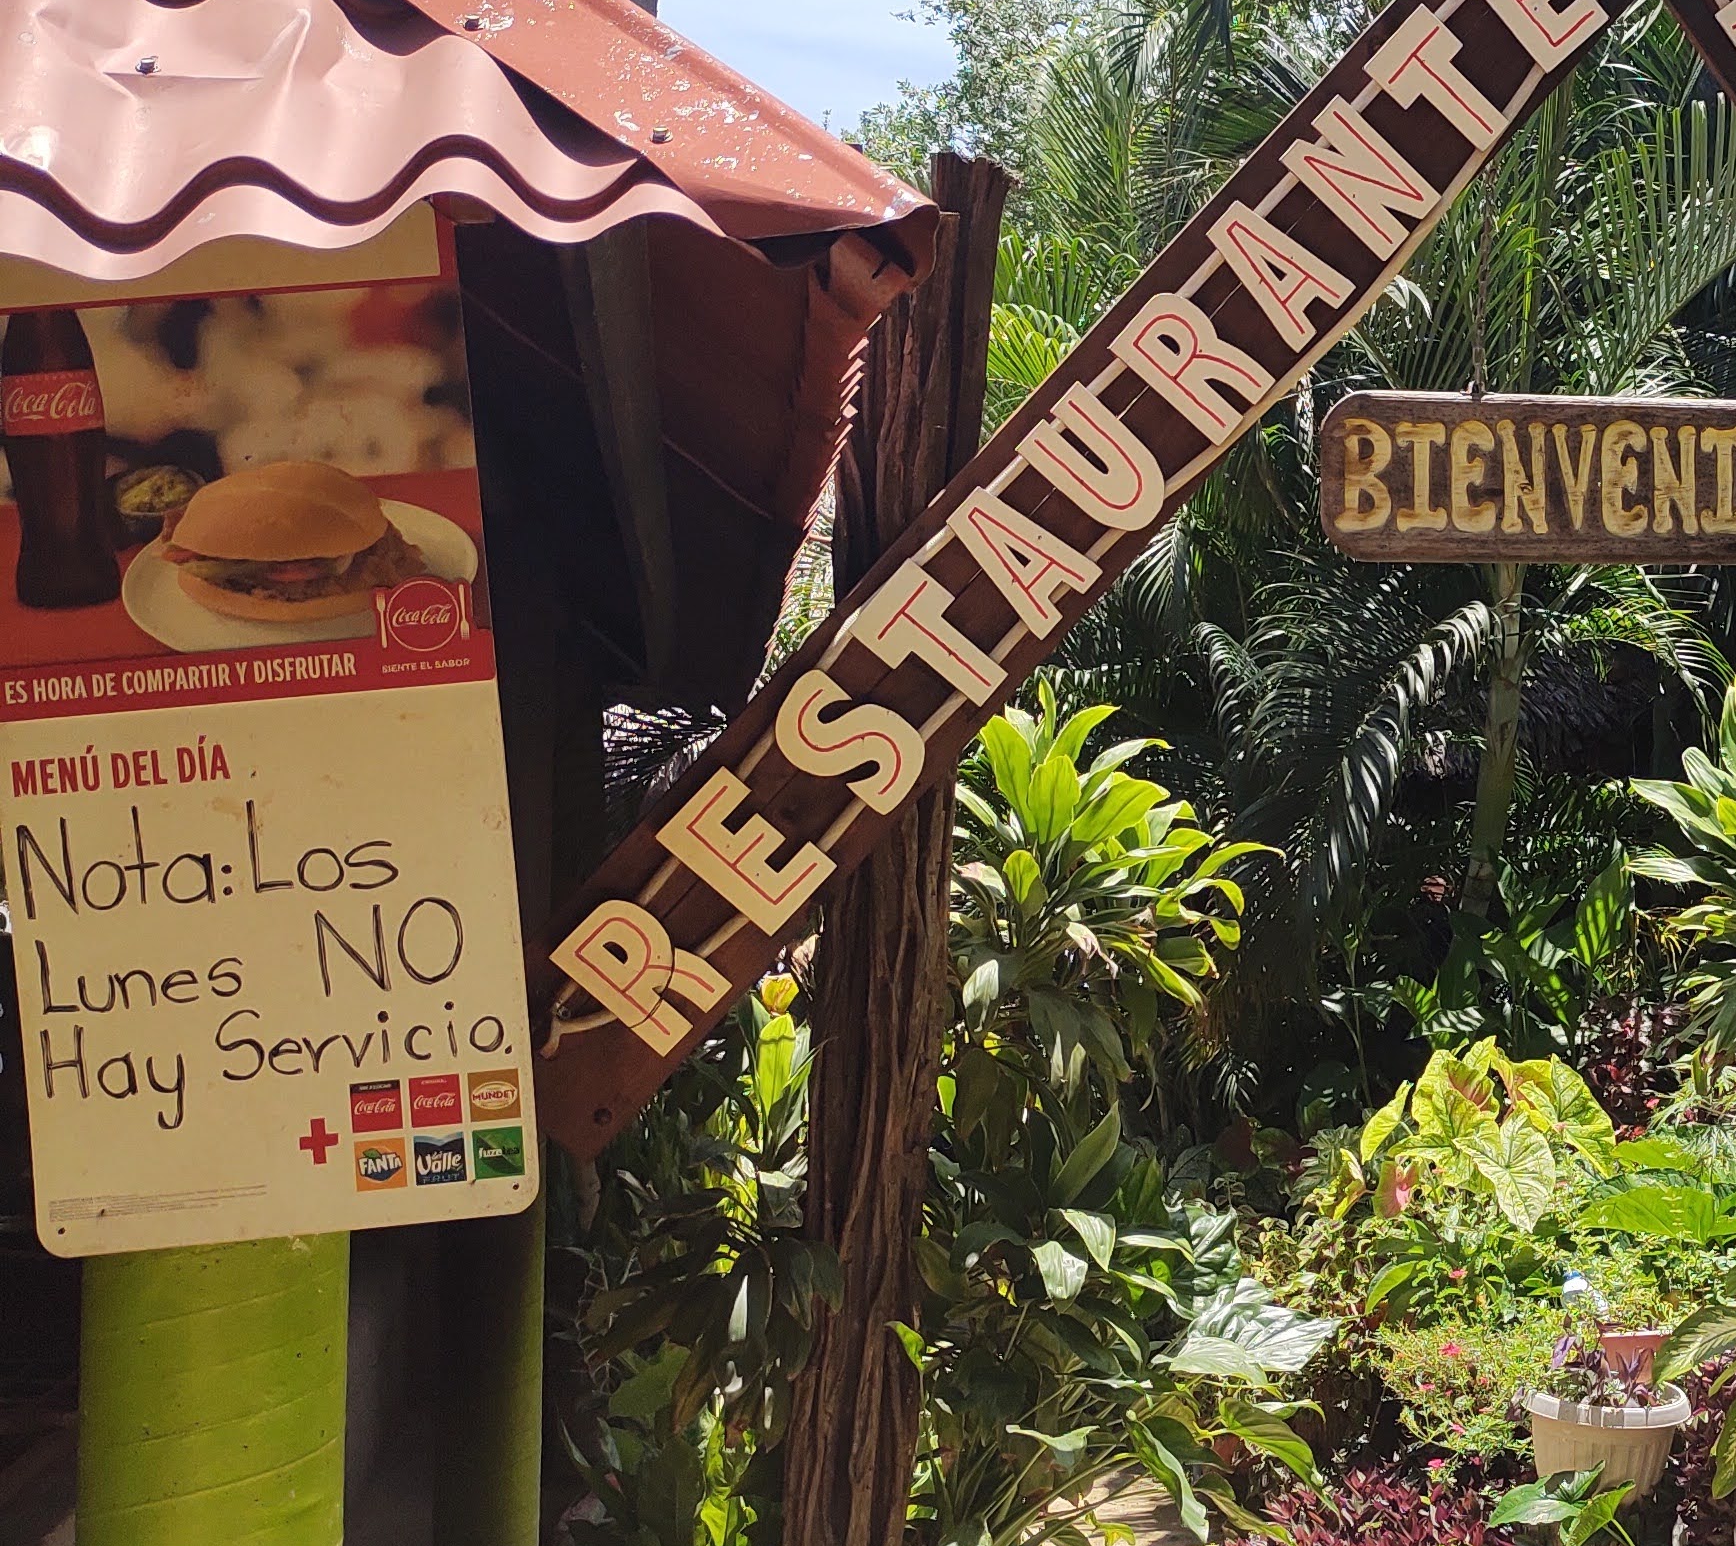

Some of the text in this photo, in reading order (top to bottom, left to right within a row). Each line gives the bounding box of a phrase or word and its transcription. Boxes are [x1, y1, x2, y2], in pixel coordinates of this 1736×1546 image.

[4, 381, 96, 423] Coca-Cola
[392, 603, 453, 627] Coca-Cola
[5, 653, 356, 704] ES HORA DE COMPARTIR Y DISFRUTAR
[382, 658, 470, 673] SIENTE EL SABOR
[11, 735, 231, 797] MENÚ DEL DÍA
[35, 896, 464, 1015] Lunes NO
[40, 1000, 514, 1130] Hay Servicio.
[358, 1151, 403, 1176] FANTA
